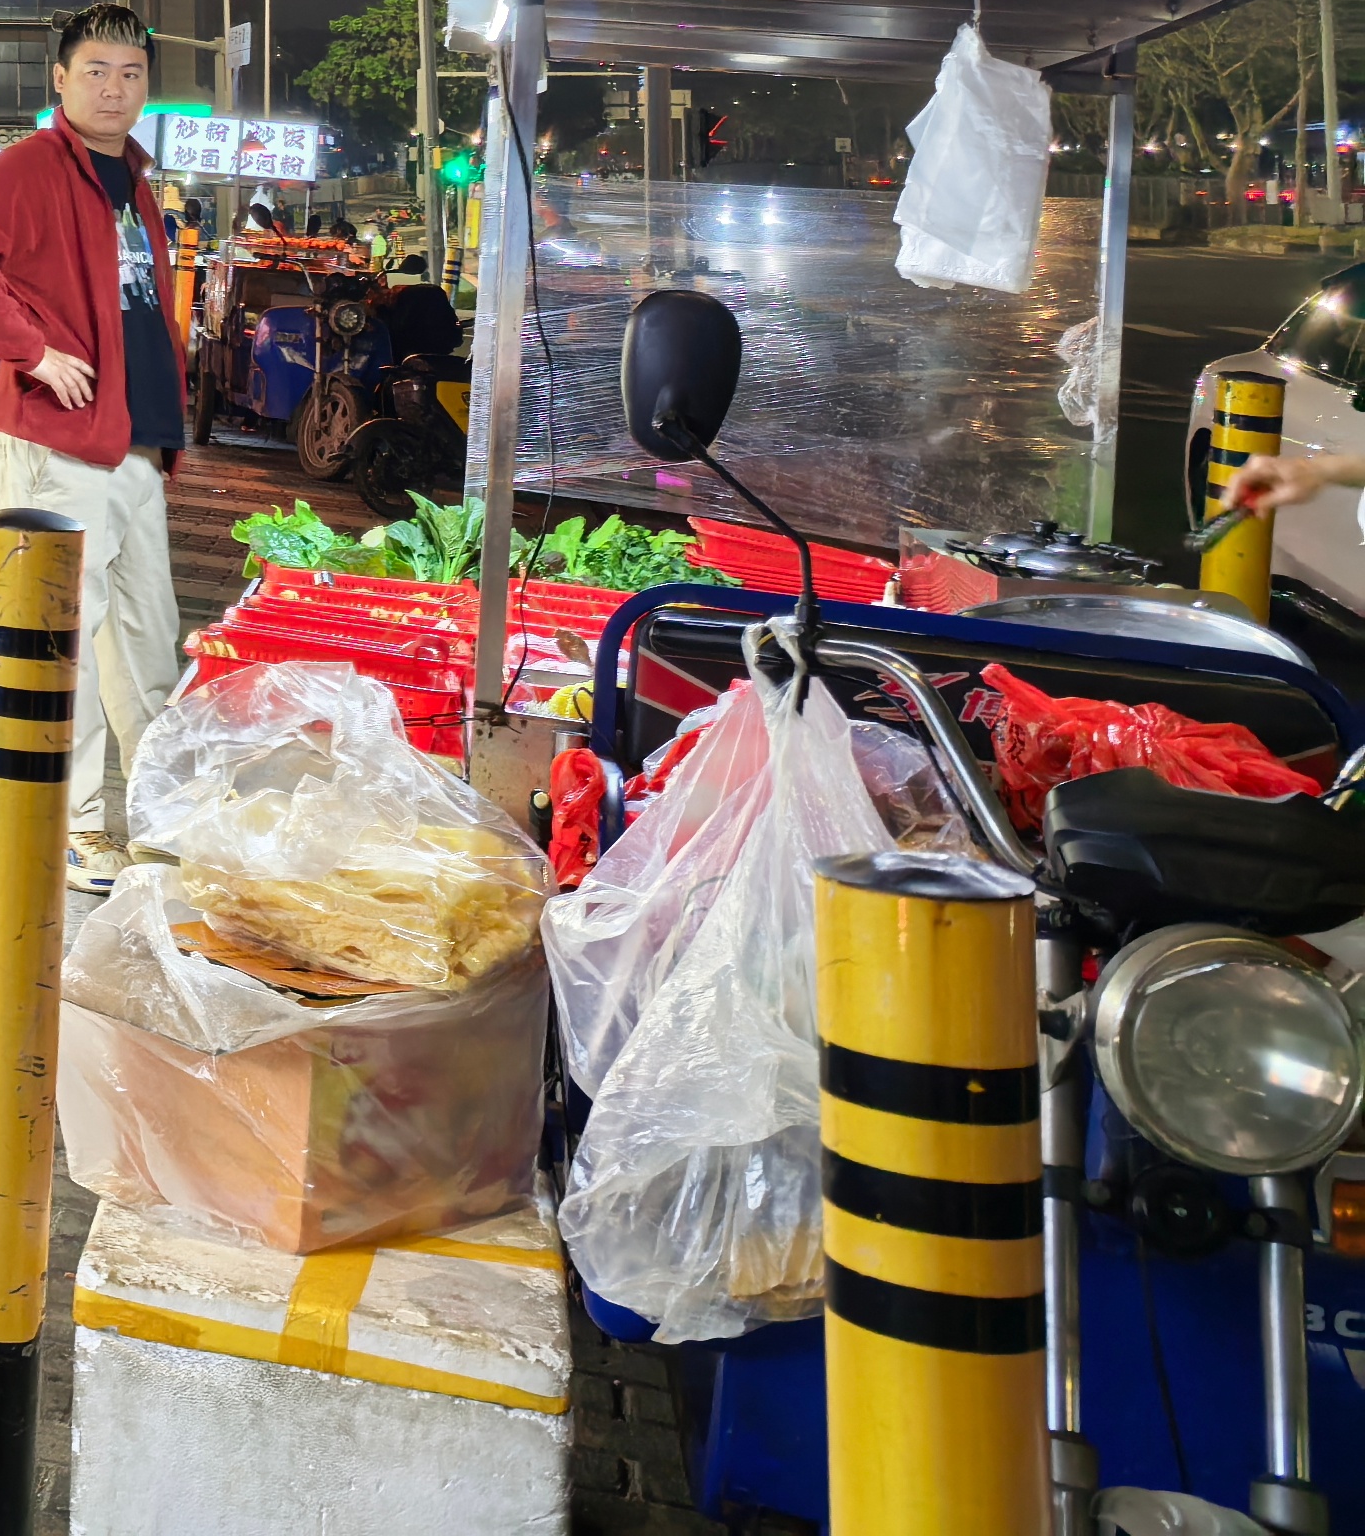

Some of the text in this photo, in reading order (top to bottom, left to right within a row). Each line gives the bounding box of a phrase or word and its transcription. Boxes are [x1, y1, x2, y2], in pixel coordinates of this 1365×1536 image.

[175, 118, 230, 143] 炒粉
[174, 146, 305, 177] 炒面 炒河粉
